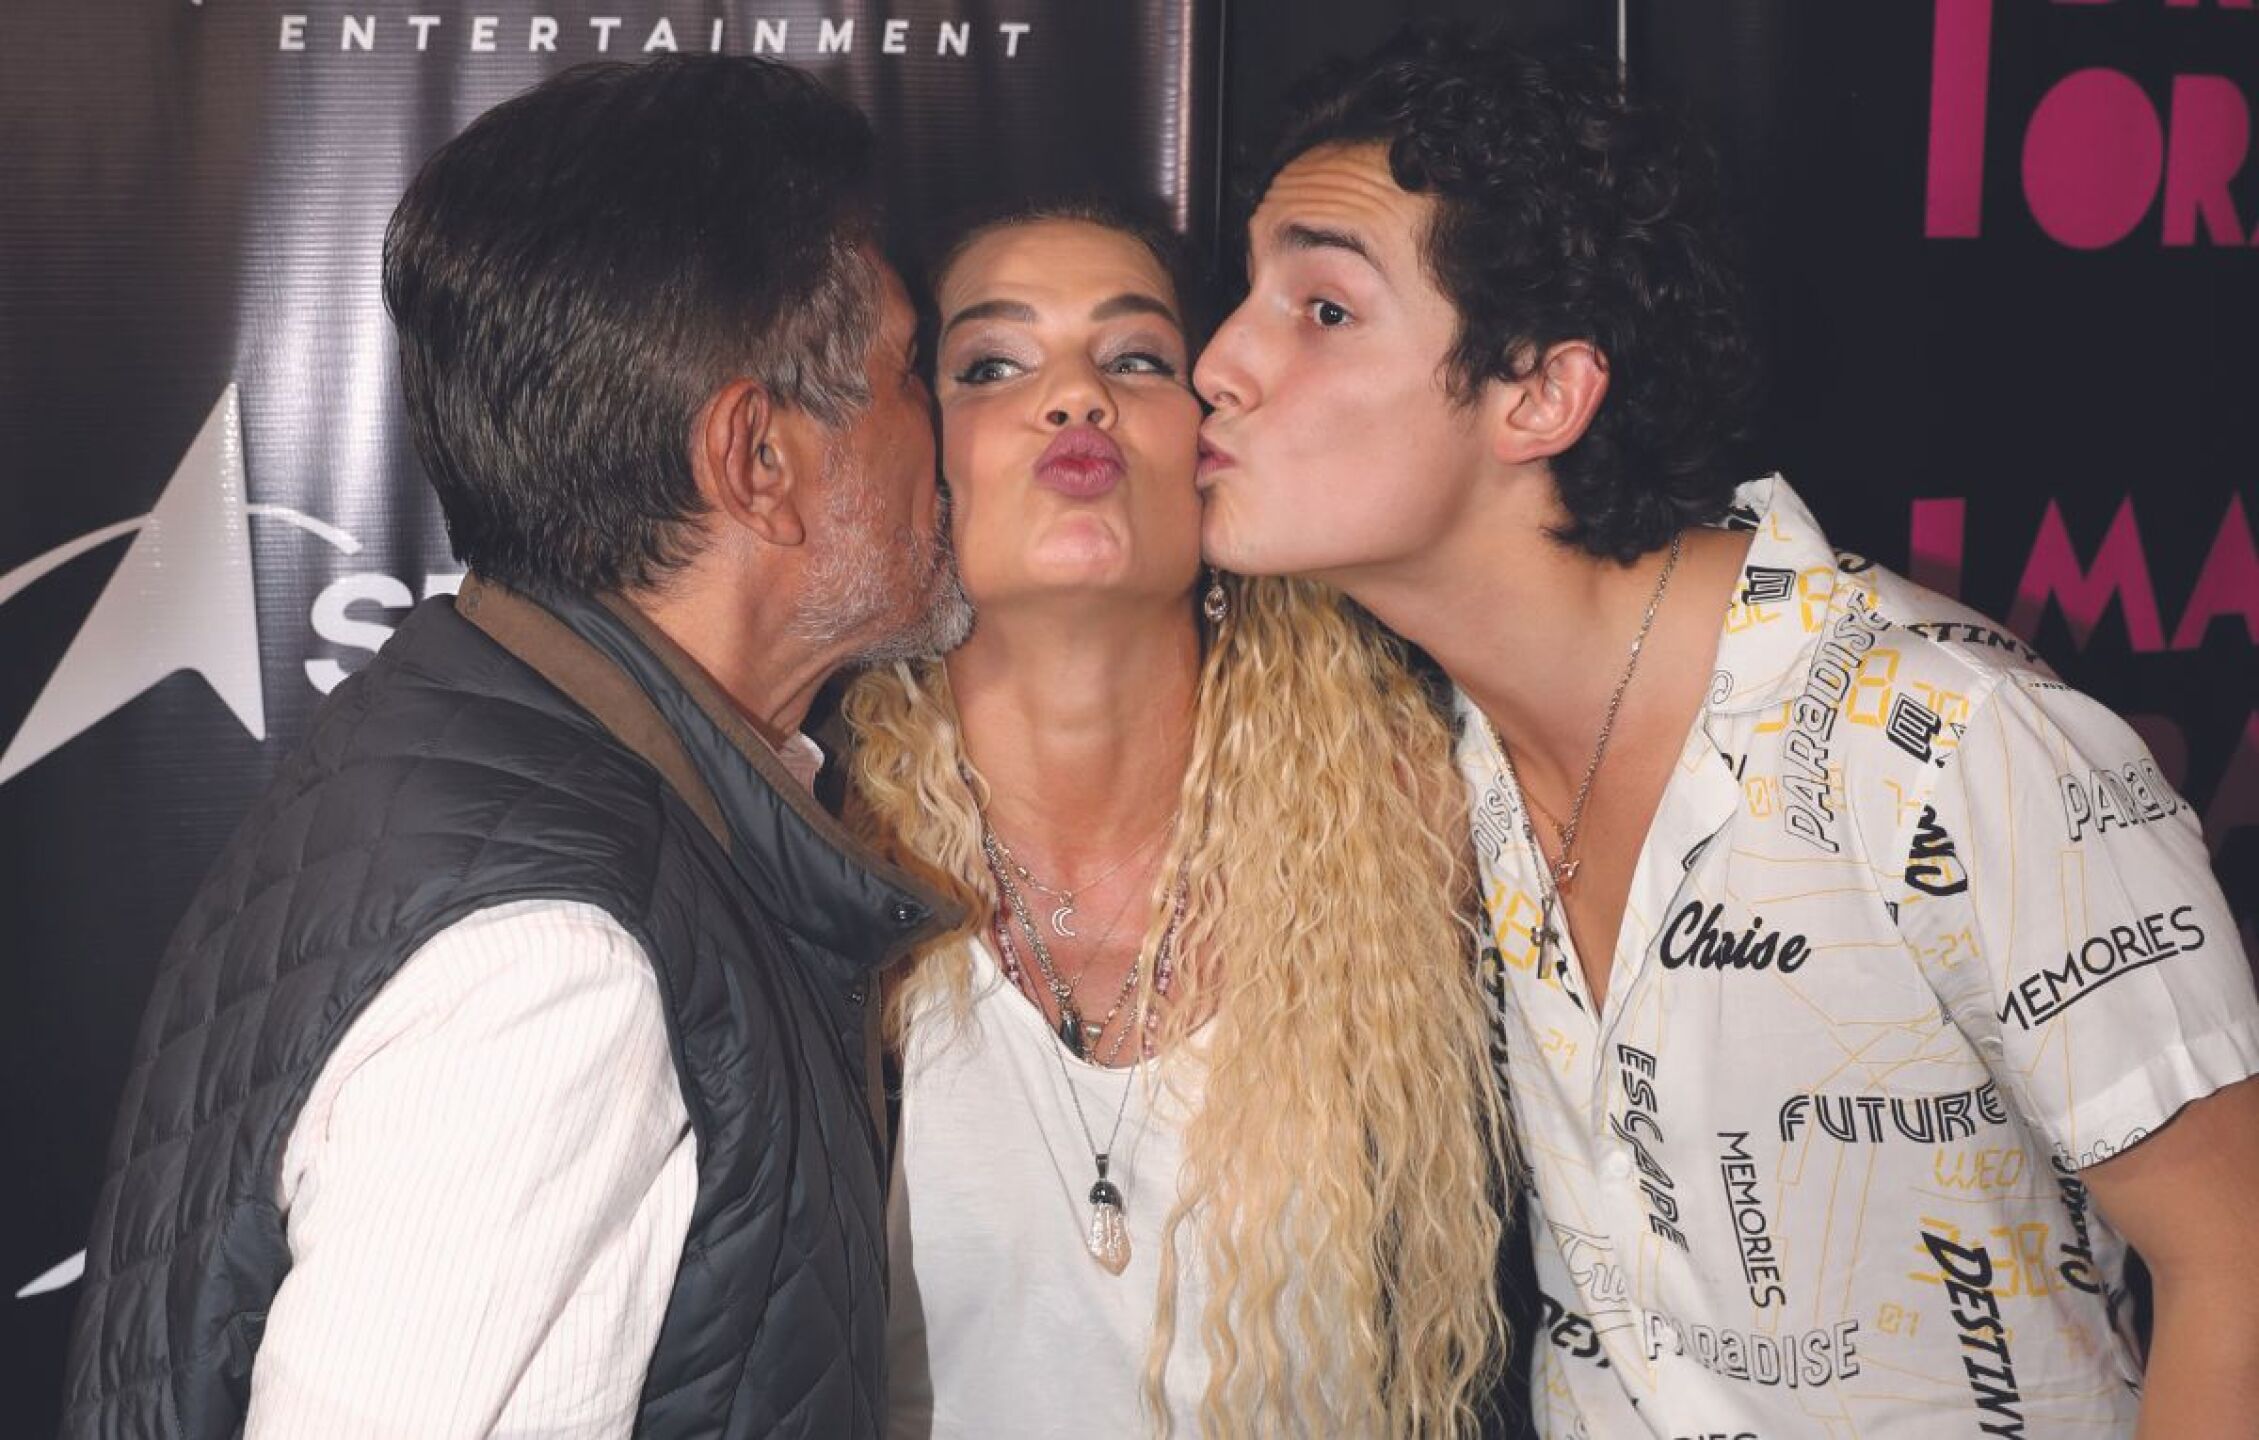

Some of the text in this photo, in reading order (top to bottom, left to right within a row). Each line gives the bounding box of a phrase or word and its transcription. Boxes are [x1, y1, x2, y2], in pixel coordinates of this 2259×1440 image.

[279, 14, 1031, 58] ENTERTAINMENT
[1609, 1043, 1690, 1252] ESCAPE
[1778, 1078, 2007, 1143] FUTURE
[1716, 1131, 1787, 1308] MEMORIES
